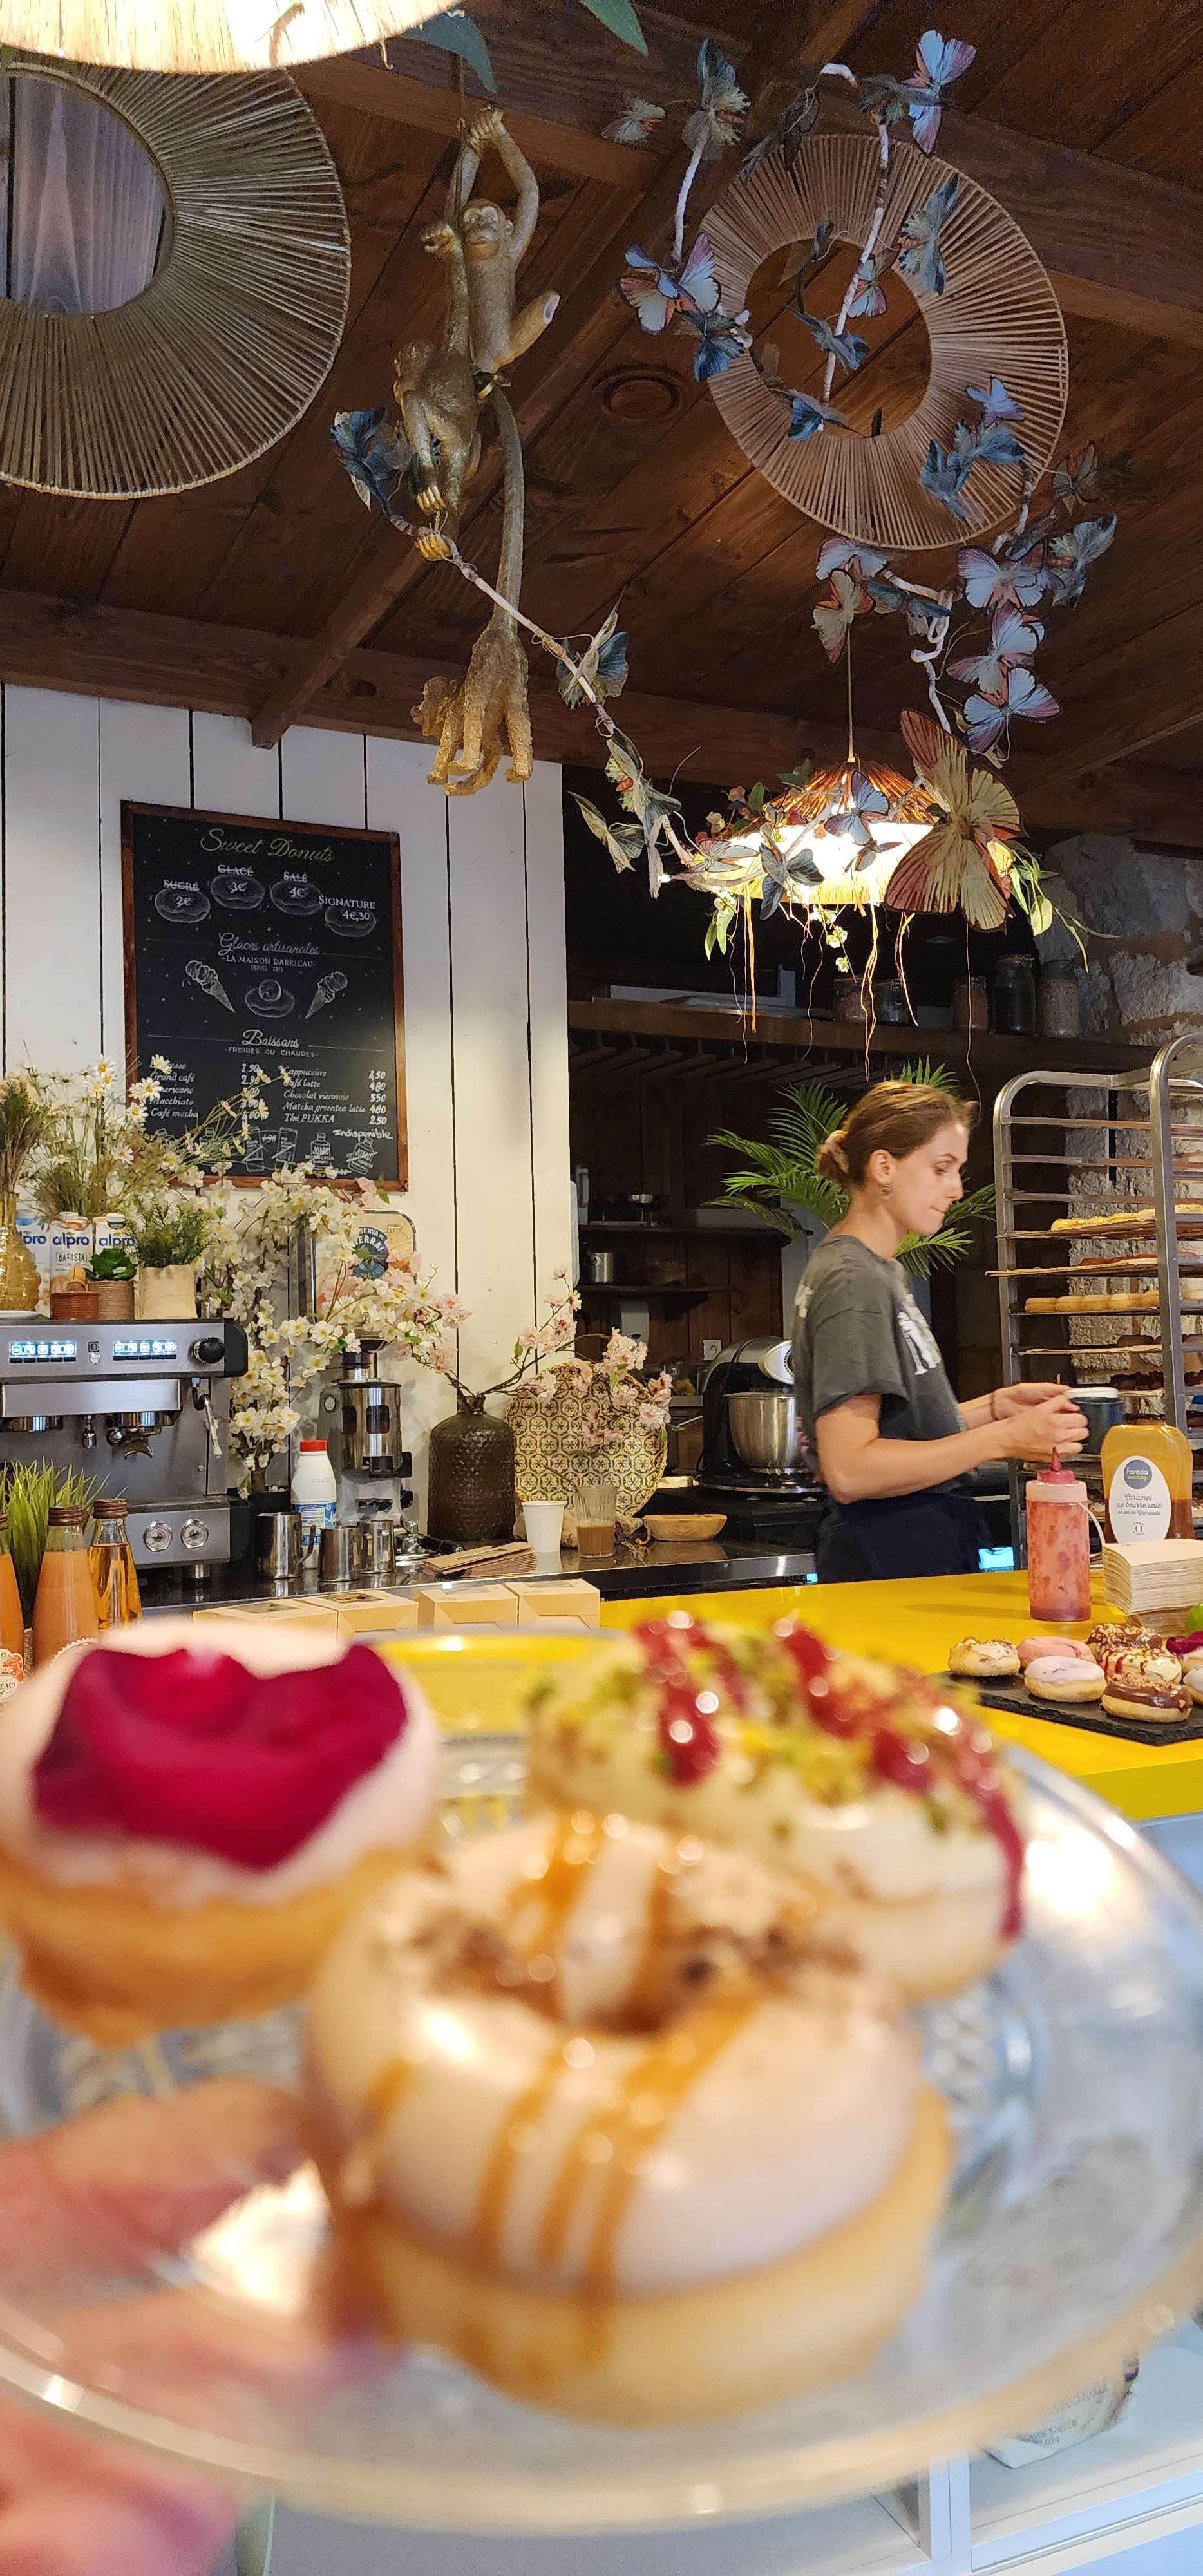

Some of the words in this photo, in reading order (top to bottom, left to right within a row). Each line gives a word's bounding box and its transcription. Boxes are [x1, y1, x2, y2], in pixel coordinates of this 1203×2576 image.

[200, 829, 263, 854] Sweet
[267, 838, 334, 862] Donuts
[218, 864, 254, 876] GLACÉ
[283, 871, 307, 883] SALÉ
[164, 879, 200, 891] SUCRÉ
[318, 895, 375, 909] SIGNATURE
[218, 933, 259, 956] Glaces
[262, 940, 319, 955] artisanales
[239, 956, 271, 965] MAISON
[242, 1029, 300, 1048] Boissons
[280, 1049, 315, 1057] CHAUDES
[178, 1072, 196, 1084] café
[303, 1077, 321, 1088] latte
[283, 1089, 317, 1099] Chocolat
[319, 1091, 350, 1101] viennois
[151, 1107, 171, 1119] Café
[282, 1101, 314, 1111] Matcha
[348, 1103, 366, 1113] latte
[284, 1113, 299, 1122] Thé
[301, 1114, 335, 1123] PUKKA
[332, 1128, 393, 1142] Indisponible
[52, 1232, 90, 1249] alpro
[58, 1253, 87, 1262] BARISTA
